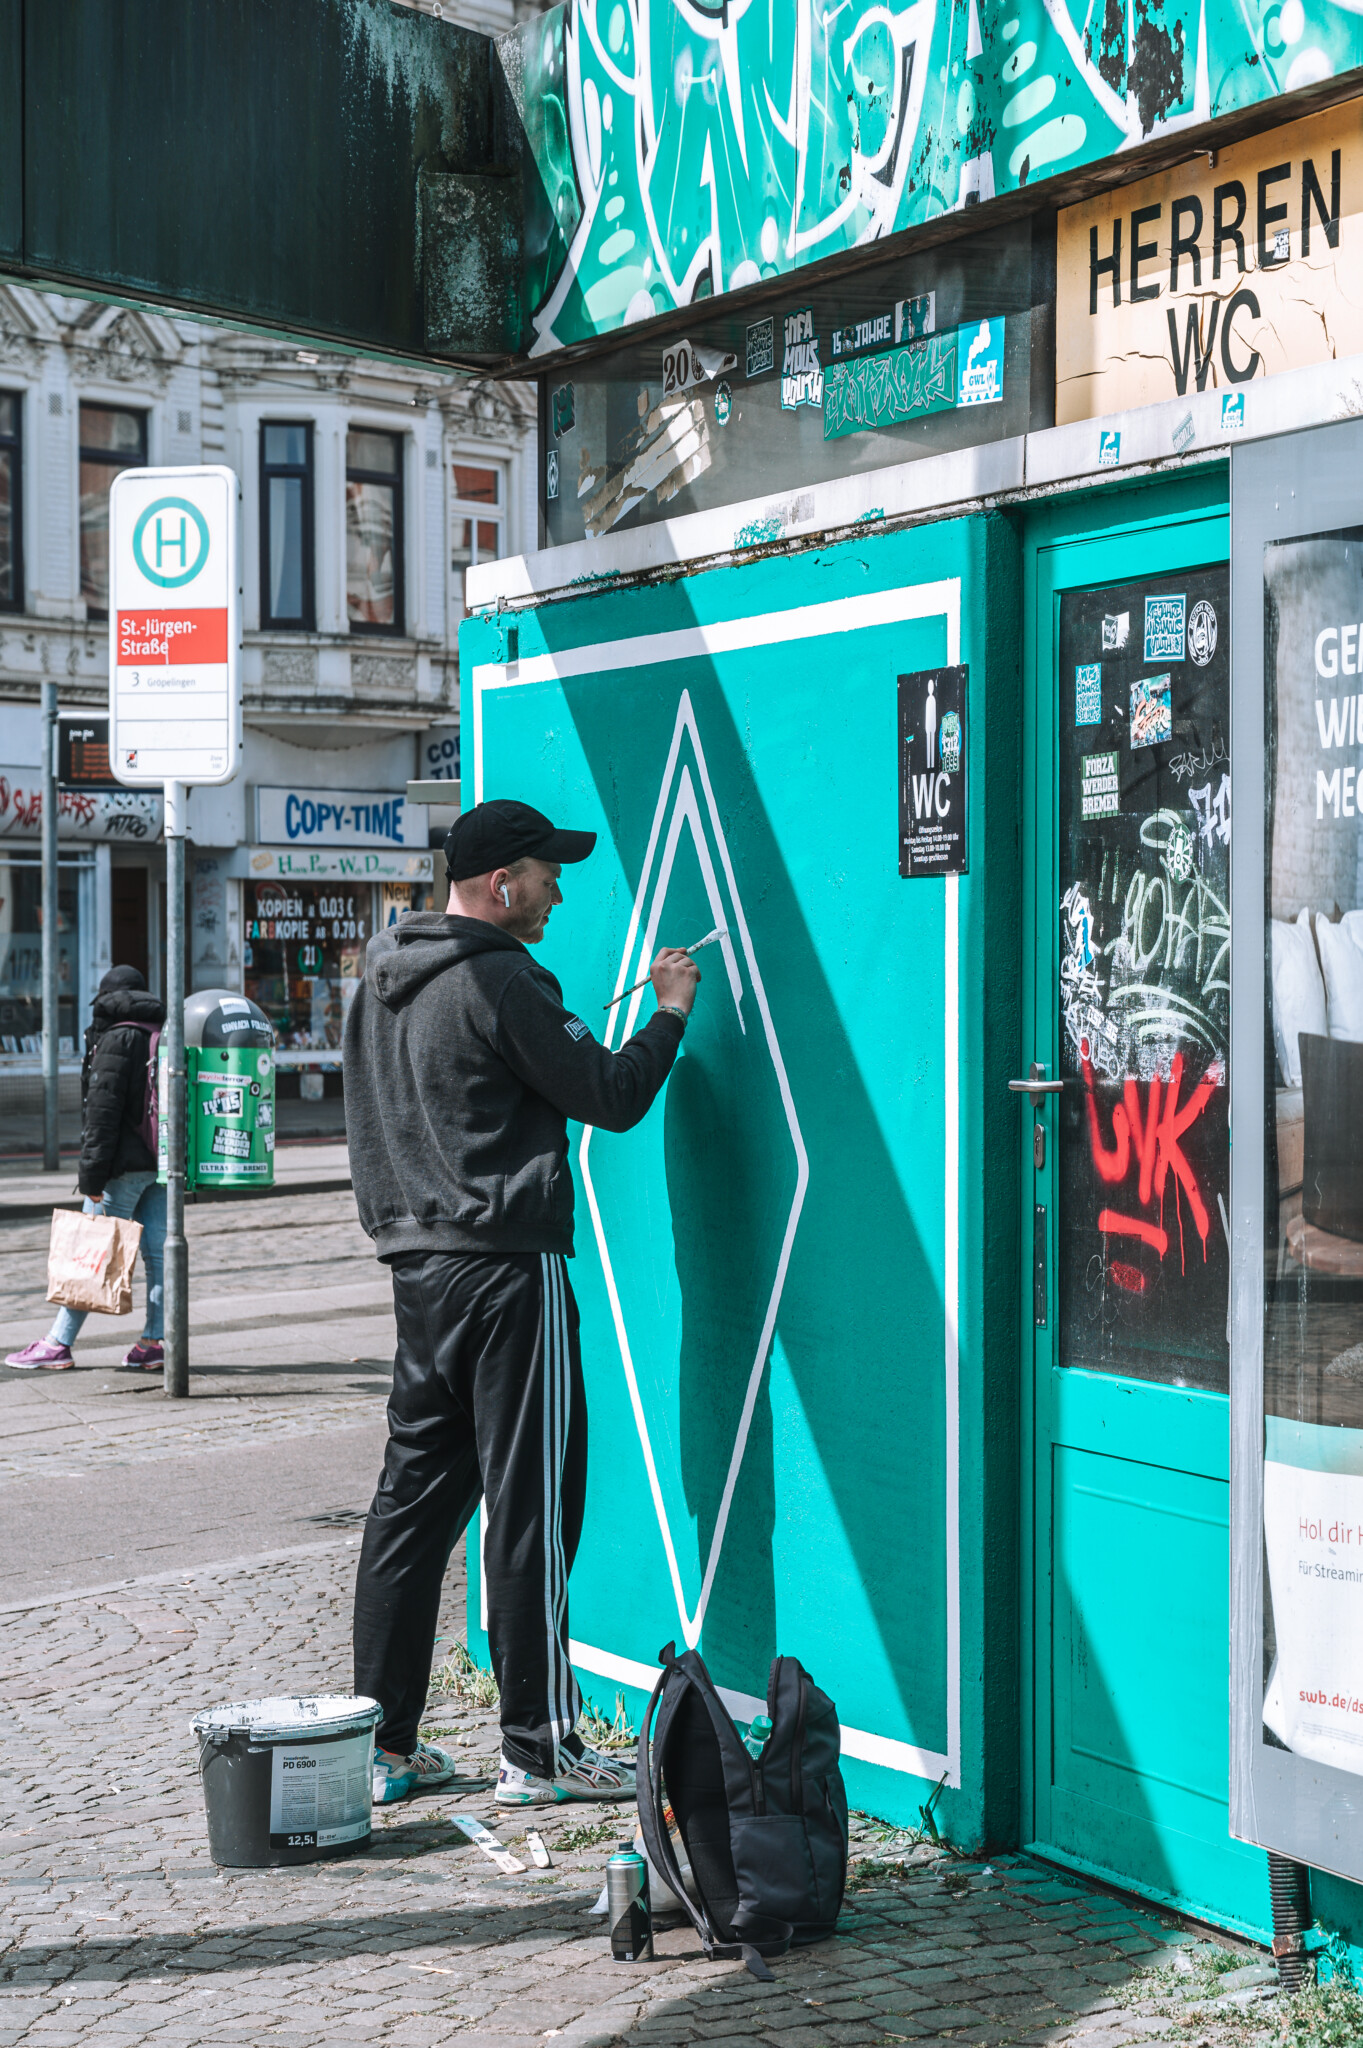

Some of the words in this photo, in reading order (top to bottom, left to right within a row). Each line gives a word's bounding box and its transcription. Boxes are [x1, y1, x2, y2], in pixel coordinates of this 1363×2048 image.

[1090, 148, 1341, 316] HERREN
[832, 331, 841, 355] 15
[854, 314, 892, 348] JAHRE
[1166, 288, 1262, 396] WC
[664, 348, 688, 394] 20
[969, 373, 985, 386] GWL
[121, 618, 197, 639] St.-Jürgen-
[121, 638, 169, 656] Straße
[1315, 622, 1363, 678] GE
[131, 672, 140, 687] 3
[147, 677, 196, 688] Gröpelingen
[430, 762, 460, 780] TI
[1086, 756, 1114, 777] FORZA
[912, 771, 951, 819] WC
[1082, 774, 1118, 796] WERDER
[1082, 793, 1119, 815] BREMEN
[286, 794, 404, 843] COPY-TIME
[385, 882, 410, 901] Neu
[257, 899, 303, 918] KOPIEN
[320, 897, 344, 918] 0.03
[245, 920, 309, 939] FARBKOPIE
[332, 920, 356, 939] 0.70
[215, 1135, 250, 1149] WERDER
[219, 1127, 248, 1140] FORZA
[213, 1143, 250, 1158] BREMEN
[1299, 1517, 1322, 1540] Hol
[1328, 1521, 1352, 1545] dir
[1299, 1560, 1312, 1576] Für
[283, 1761, 295, 1769] PD
[296, 1760, 316, 1768] 6900
[288, 1834, 315, 1846] 12,5L
